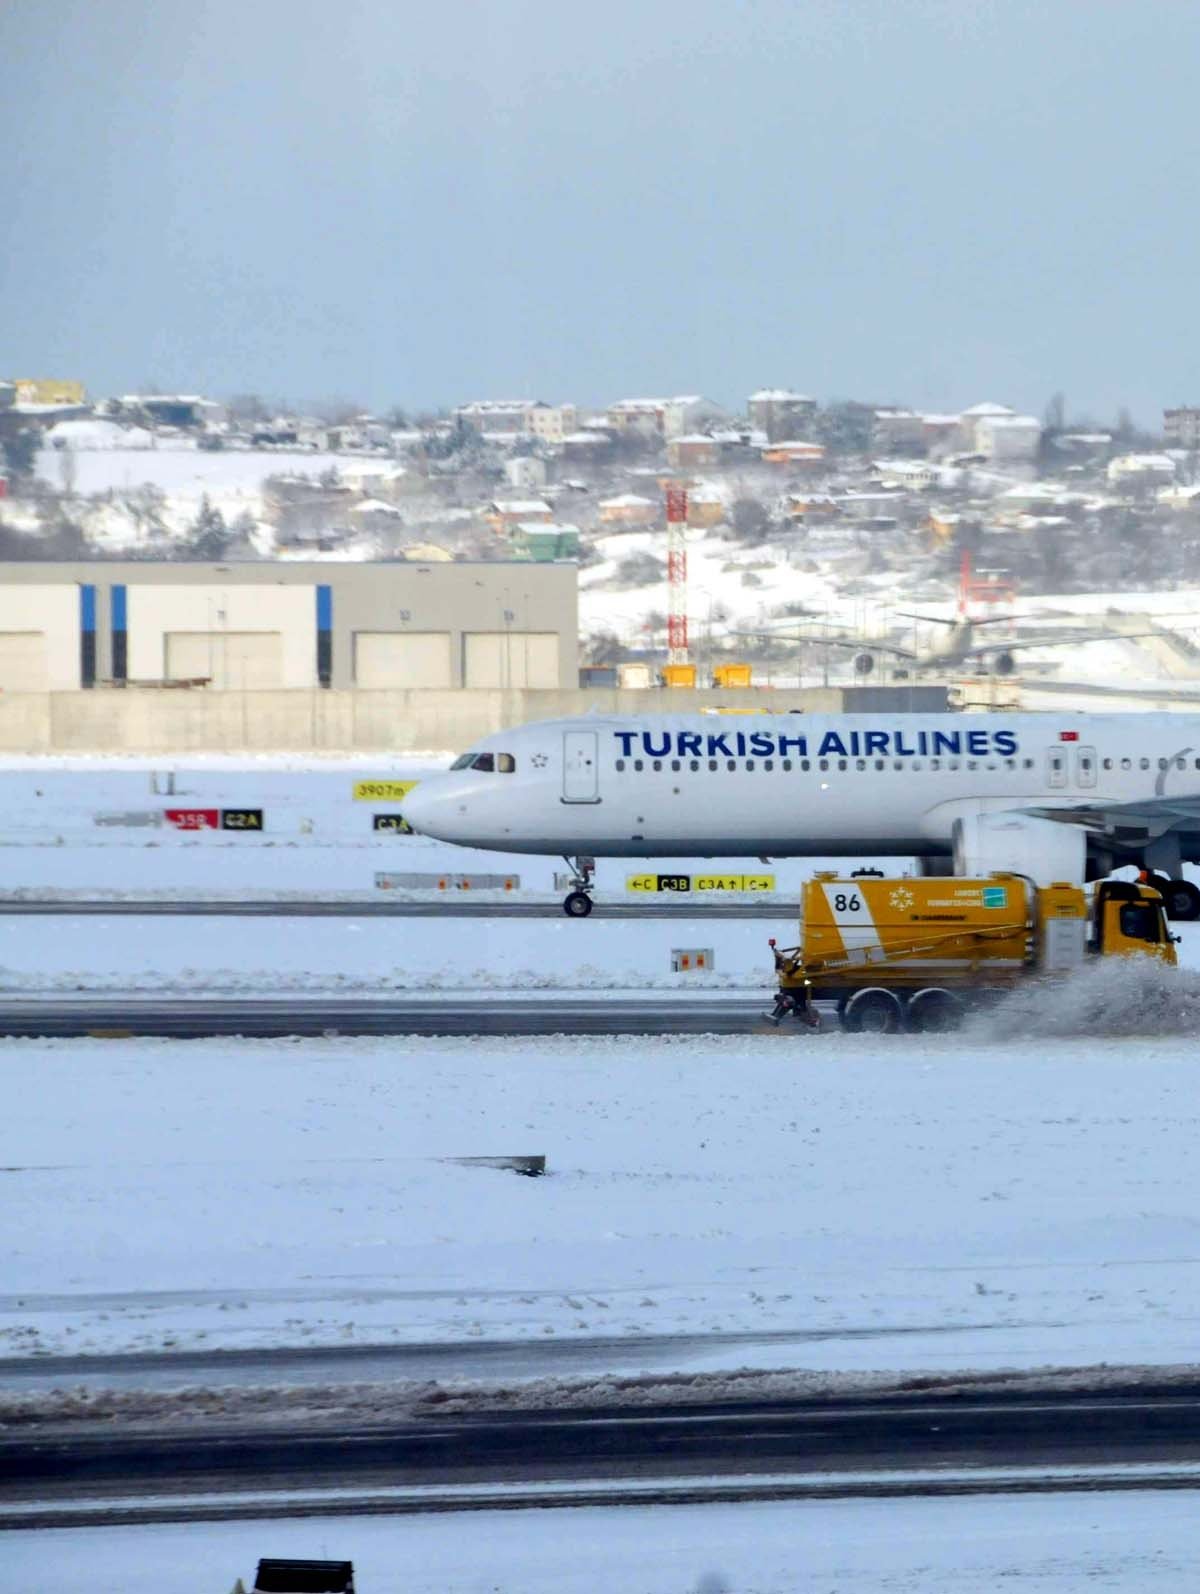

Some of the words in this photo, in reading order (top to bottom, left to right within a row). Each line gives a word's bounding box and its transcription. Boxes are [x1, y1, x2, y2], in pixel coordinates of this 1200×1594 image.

[614, 731, 807, 757] TURKISH
[818, 731, 1018, 757] AIRLINES
[358, 784, 405, 797] 3907m
[225, 813, 258, 827] C2A
[643, 879, 651, 890] C
[660, 878, 688, 891] C3B
[698, 879, 725, 890] C3A
[834, 893, 861, 912] 86
